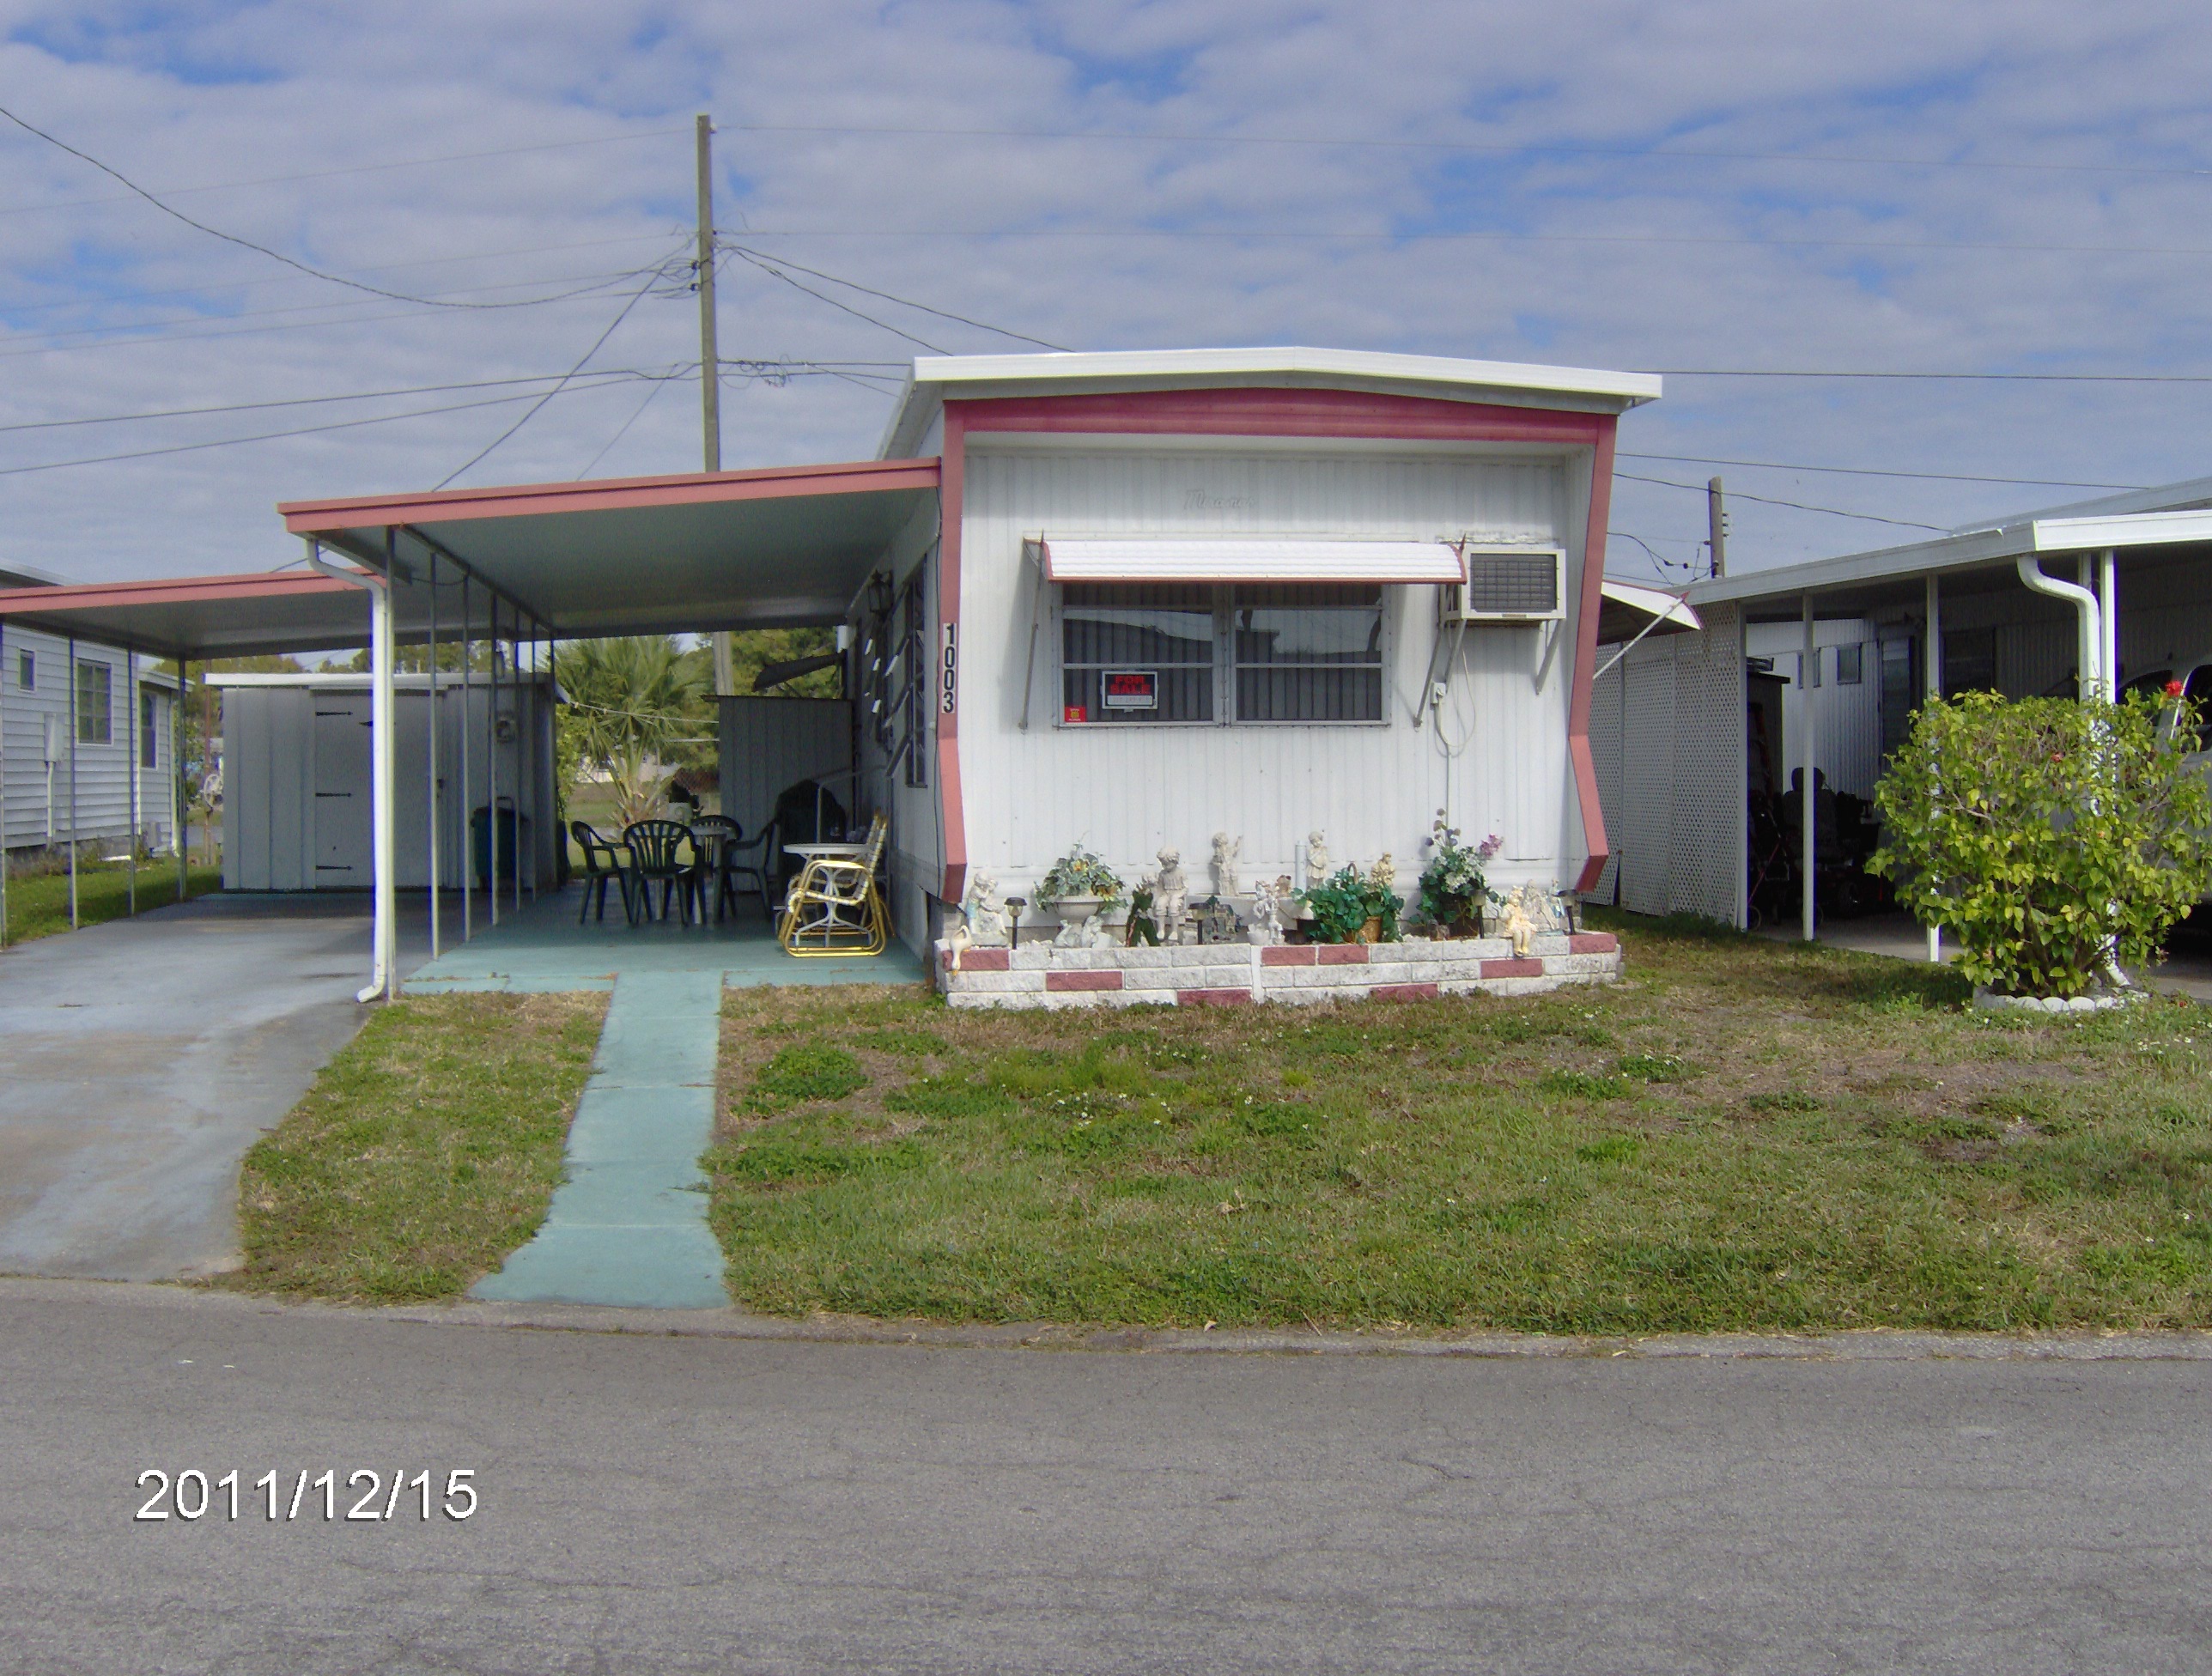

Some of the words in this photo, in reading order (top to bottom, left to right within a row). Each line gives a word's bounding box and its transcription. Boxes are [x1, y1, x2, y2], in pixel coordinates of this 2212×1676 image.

[942, 622, 956, 714] 1003
[1115, 675, 1146, 683] FOR
[1109, 684, 1151, 695] SALE
